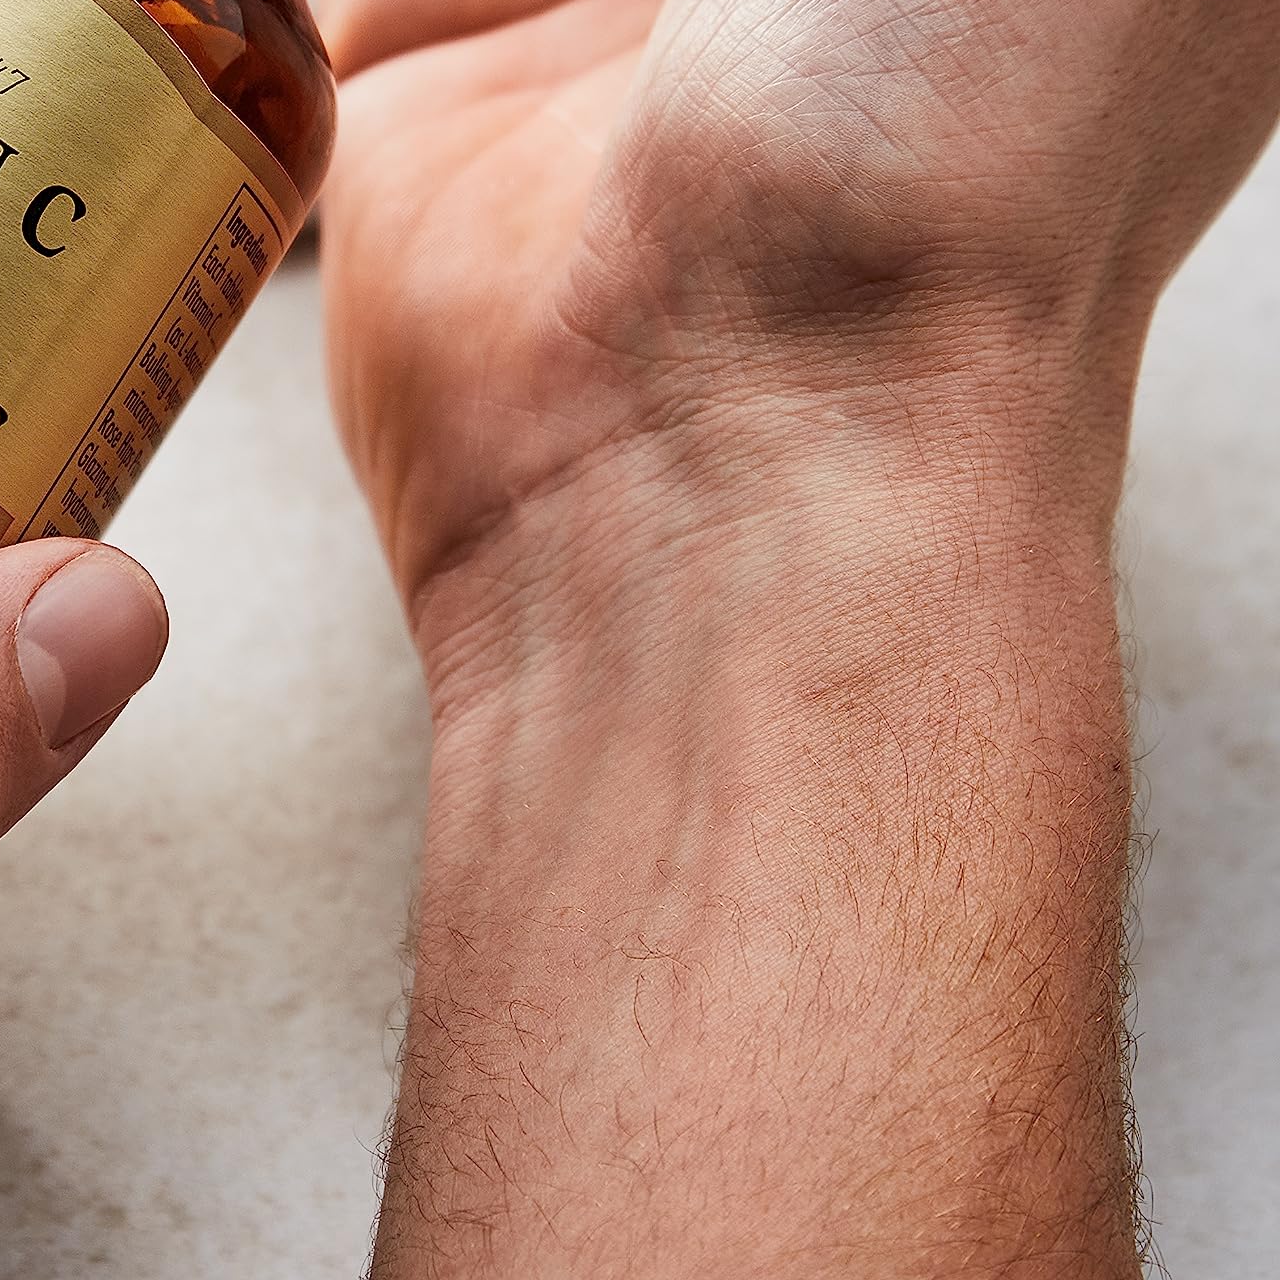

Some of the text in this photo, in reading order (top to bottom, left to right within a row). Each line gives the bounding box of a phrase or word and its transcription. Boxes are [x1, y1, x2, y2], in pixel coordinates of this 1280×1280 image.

[22, 185, 87, 257] C
[202, 245, 229, 285] Each
[180, 277, 216, 329] Vitamin
[164, 317, 187, 351] (as
[139, 342, 175, 399] Bulking
[97, 408, 123, 450] Rose
[78, 442, 109, 497] Glazing
